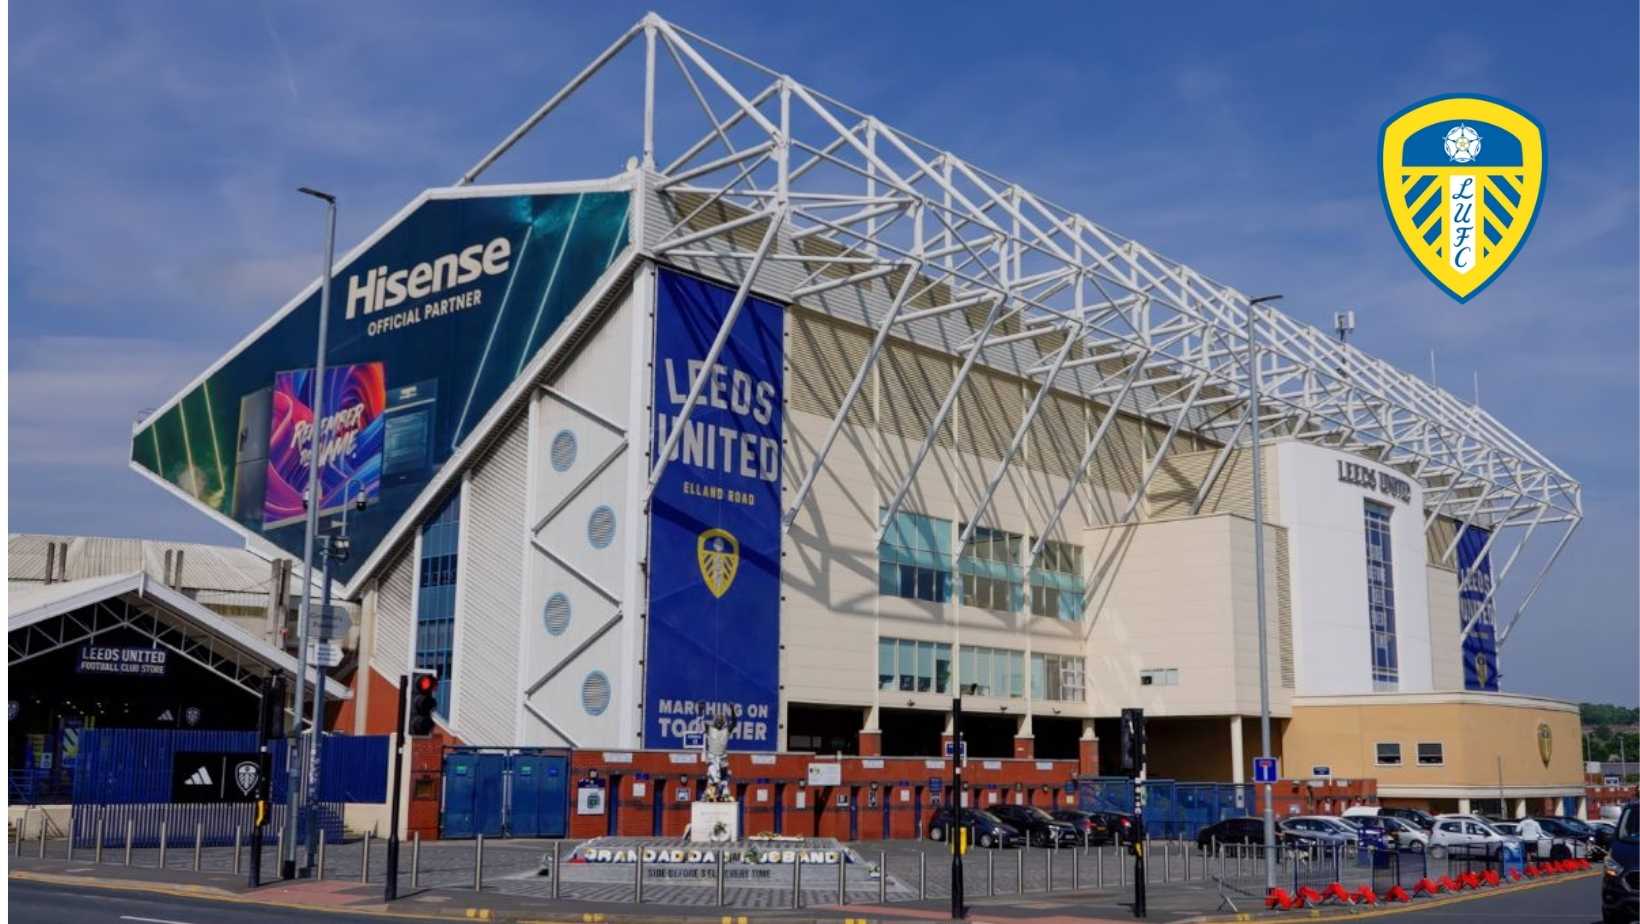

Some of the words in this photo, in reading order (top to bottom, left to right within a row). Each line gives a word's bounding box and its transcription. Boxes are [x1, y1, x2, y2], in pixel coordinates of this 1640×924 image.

[345, 237, 511, 320] Hisense
[367, 308, 421, 337] OFFICIAL
[424, 289, 481, 320] PARTNER
[664, 358, 775, 425] LEEDS
[658, 413, 779, 482] UNITED
[683, 481, 723, 500] ELLAND
[727, 490, 755, 505] ROAD
[1337, 459, 1377, 491] LEEDS
[1378, 471, 1411, 505] UNITED
[80, 661, 119, 672] FOOTBALL
[120, 662, 139, 673] CLUB
[141, 664, 164, 674] STORE
[82, 647, 119, 661] LEEDS
[122, 649, 166, 663] UNITED
[747, 704, 768, 718] ON
[658, 717, 767, 741] TOGHER
